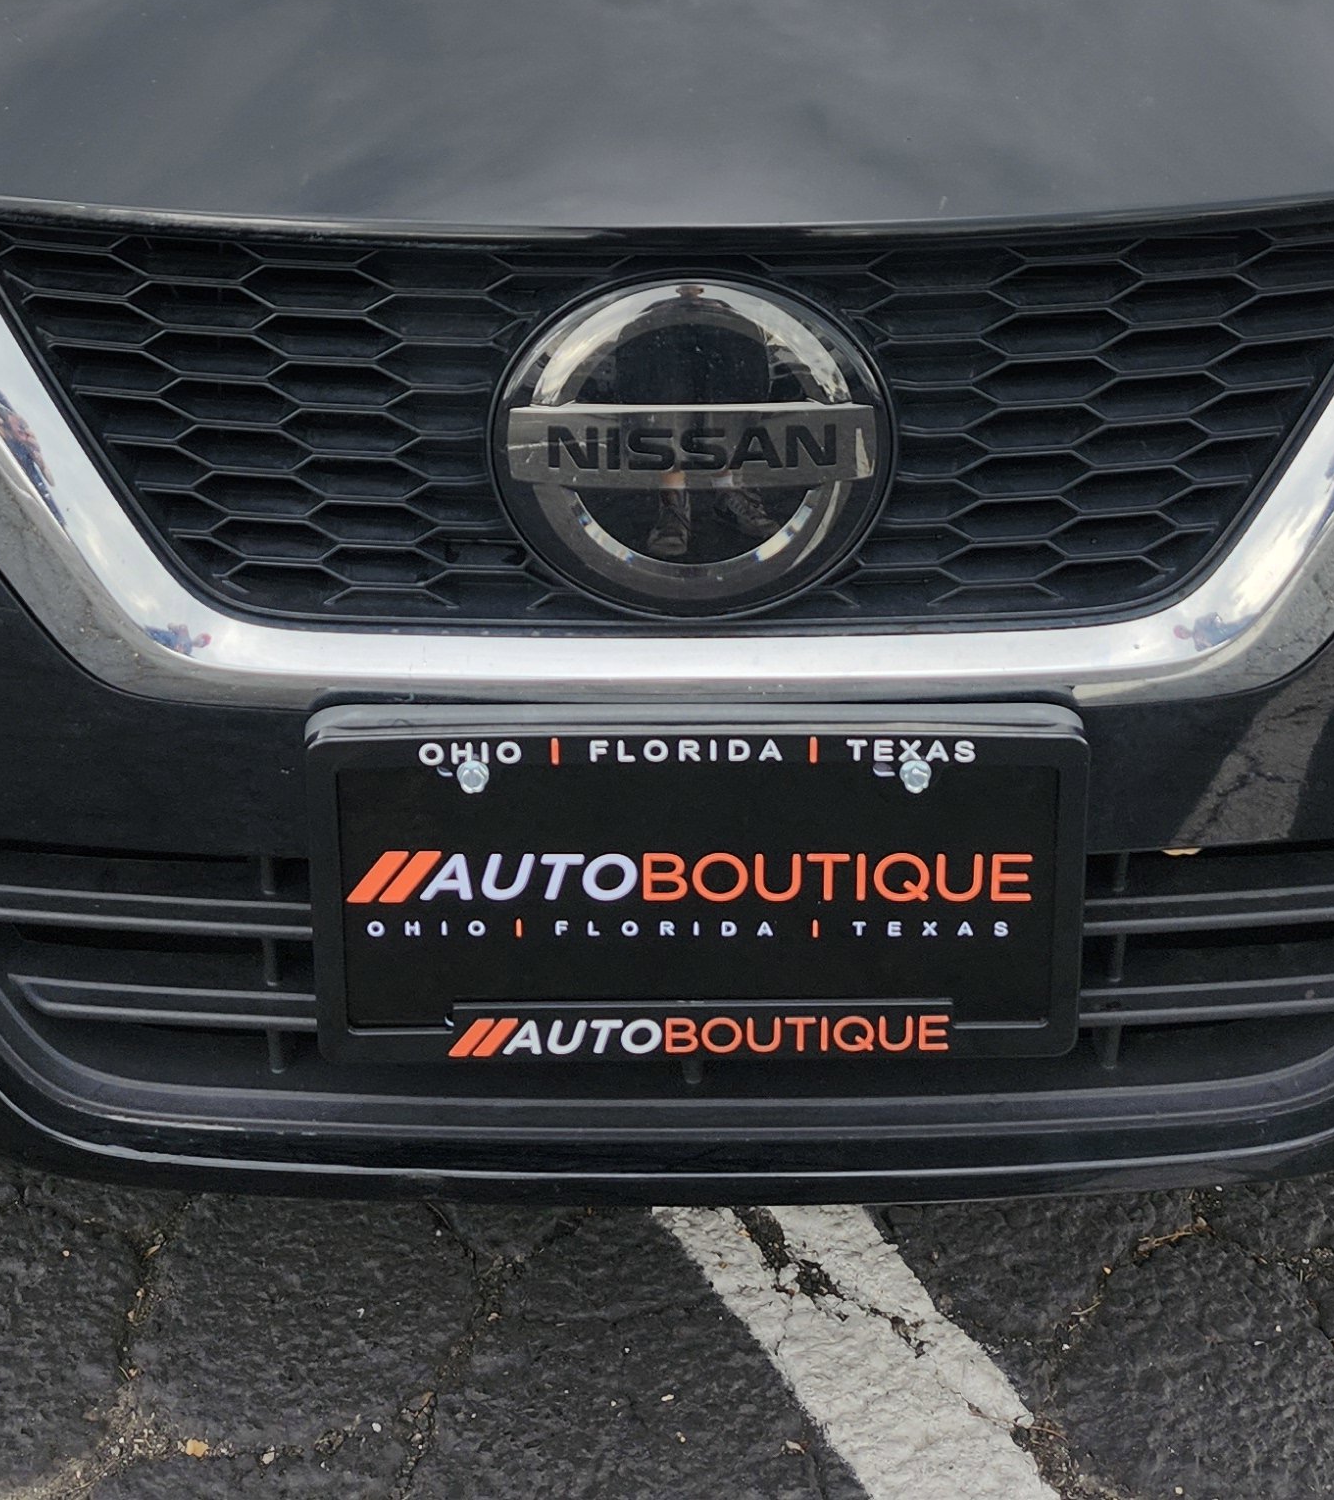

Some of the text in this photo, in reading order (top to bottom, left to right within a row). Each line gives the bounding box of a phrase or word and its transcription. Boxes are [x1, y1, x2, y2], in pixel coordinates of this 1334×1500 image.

[547, 423, 837, 471] NISSAN
[419, 739, 976, 766] OHIO FLORIDA TEXAS
[419, 852, 1034, 902] AUTOBOUTIQUE
[367, 920, 1009, 937] OHIO FLORIDA TEXAS
[502, 1014, 950, 1055] AUTOBOUTIQUE
